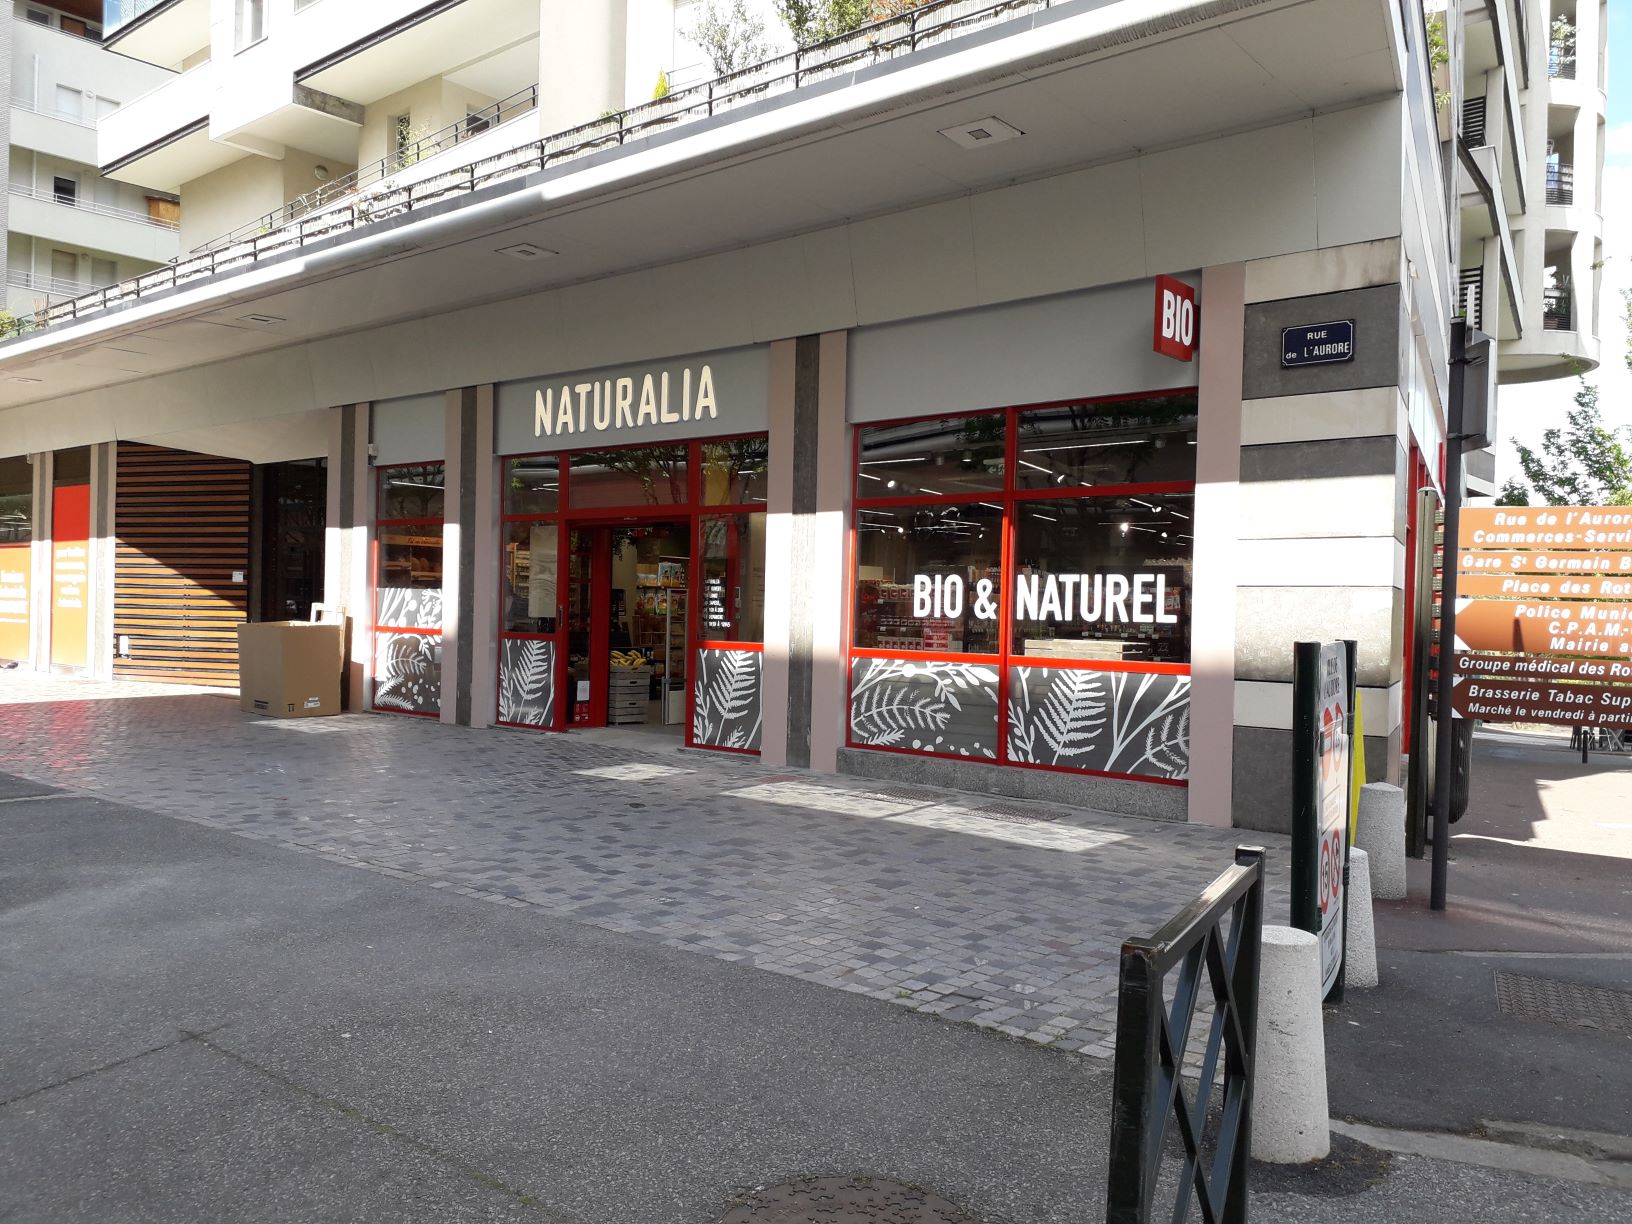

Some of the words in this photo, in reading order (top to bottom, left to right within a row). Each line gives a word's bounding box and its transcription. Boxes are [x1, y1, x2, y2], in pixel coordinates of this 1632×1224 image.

[1162, 289, 1194, 347] BIO
[1307, 330, 1327, 340] RUE
[1304, 341, 1350, 357] L'AURORE
[534, 365, 717, 437] NATURALIA
[1494, 512, 1528, 526] Rue
[1536, 512, 1558, 526] de
[1565, 511, 1632, 526] l'Auror
[1462, 554, 1502, 569] Gare
[1535, 555, 1611, 570] Germain
[1502, 579, 1551, 594] Place
[1560, 580, 1591, 595] des
[913, 574, 964, 619] BIO
[974, 578, 998, 620] &
[1016, 573, 1178, 624] NATUREL
[1514, 604, 1571, 619] Police
[1550, 636, 1609, 652] Mairie
[1459, 656, 1511, 673] Groupe
[1515, 659, 1575, 674] médical
[1578, 661, 1606, 675] des
[1610, 662, 1632, 677] Ro
[1469, 685, 1540, 701] Brasserie
[1548, 689, 1594, 704] Tabac
[1468, 703, 1512, 716] Marché
[1515, 705, 1527, 716] le
[1531, 708, 1584, 720] vendredi
[1588, 710, 1596, 721] à
